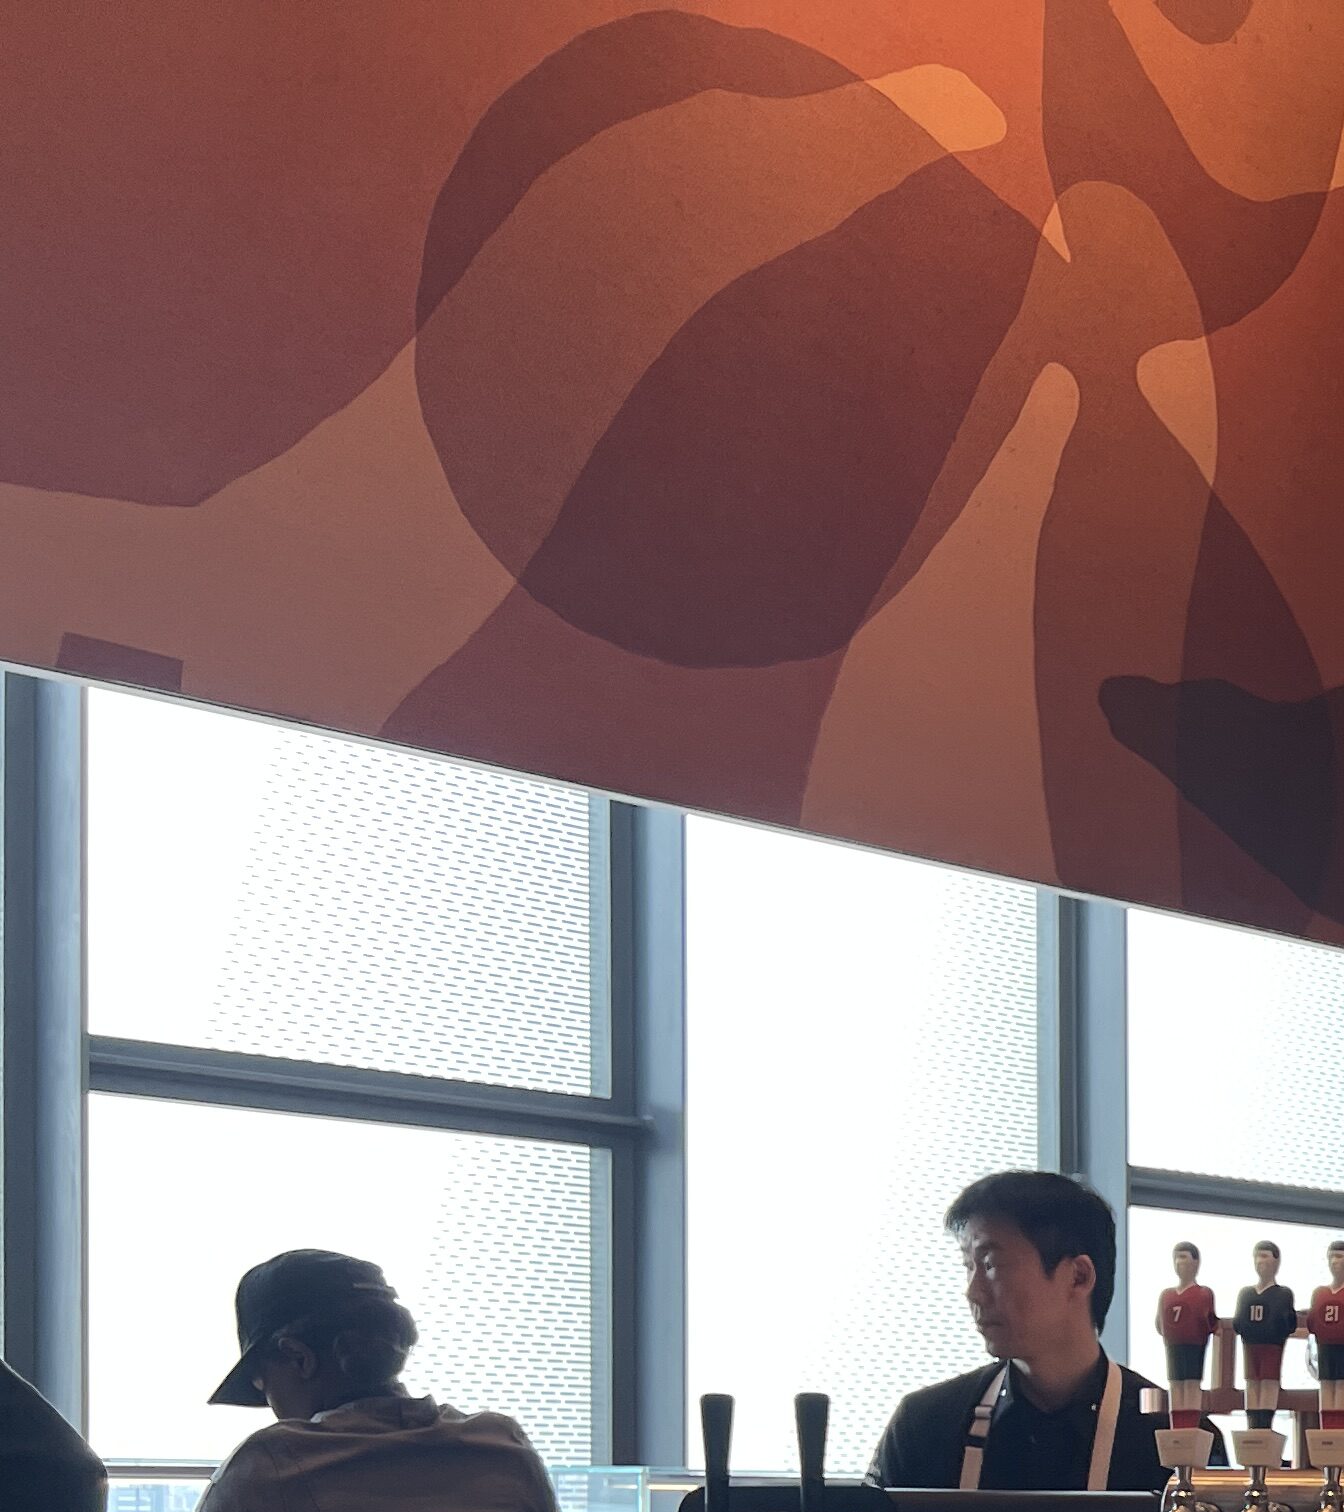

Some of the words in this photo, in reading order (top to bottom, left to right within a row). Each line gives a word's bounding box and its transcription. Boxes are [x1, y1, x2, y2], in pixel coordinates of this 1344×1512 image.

[1172, 1305, 1182, 1322] 7
[1250, 1305, 1264, 1321] 10
[1324, 1305, 1339, 1322] 21
